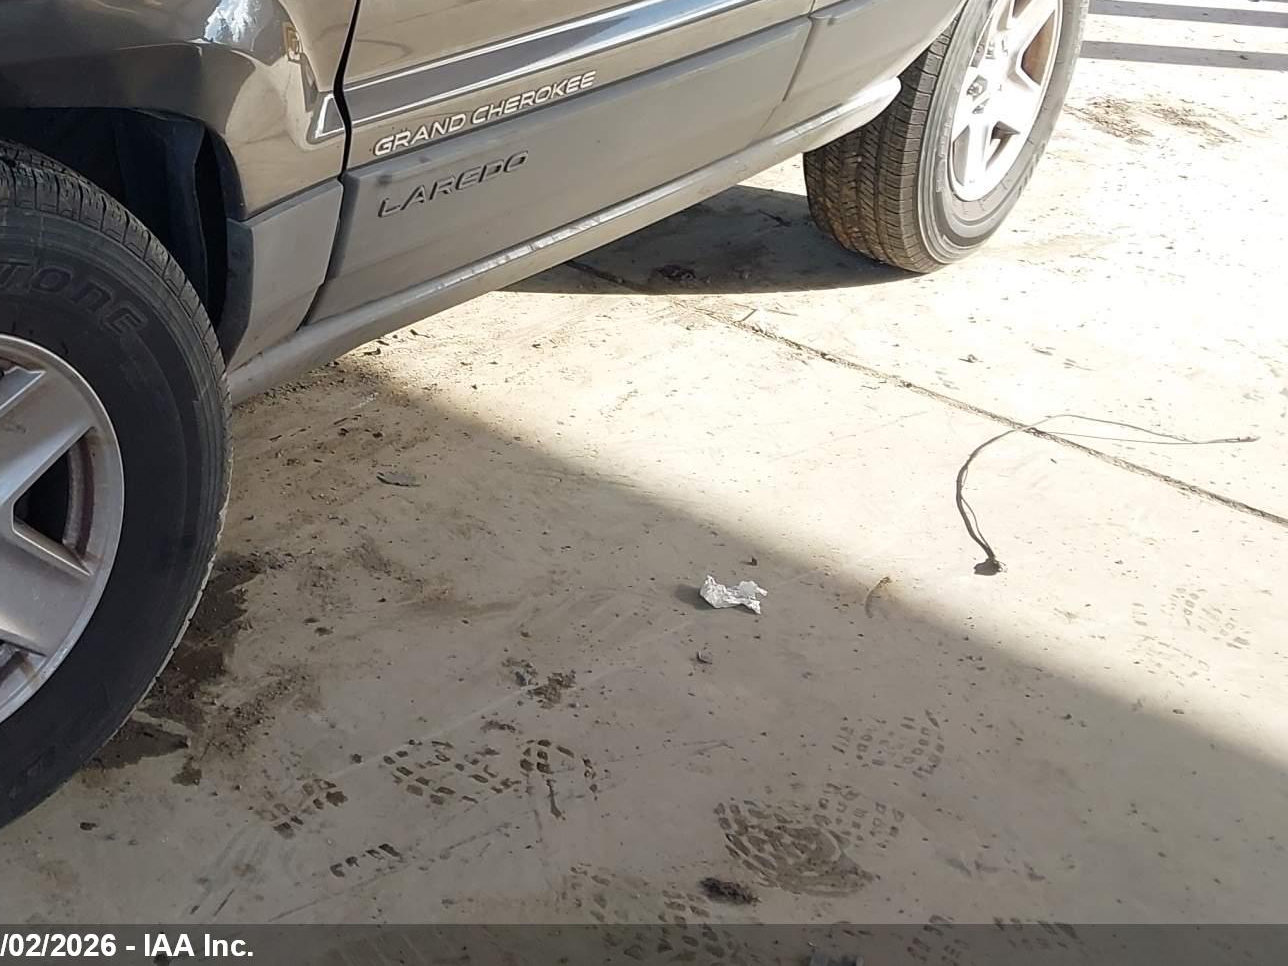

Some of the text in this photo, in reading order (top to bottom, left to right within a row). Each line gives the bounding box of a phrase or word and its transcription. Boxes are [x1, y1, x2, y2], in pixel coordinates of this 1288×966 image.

[373, 71, 598, 156] GRAND CHEROKEE
[377, 150, 529, 218] LAREDO
